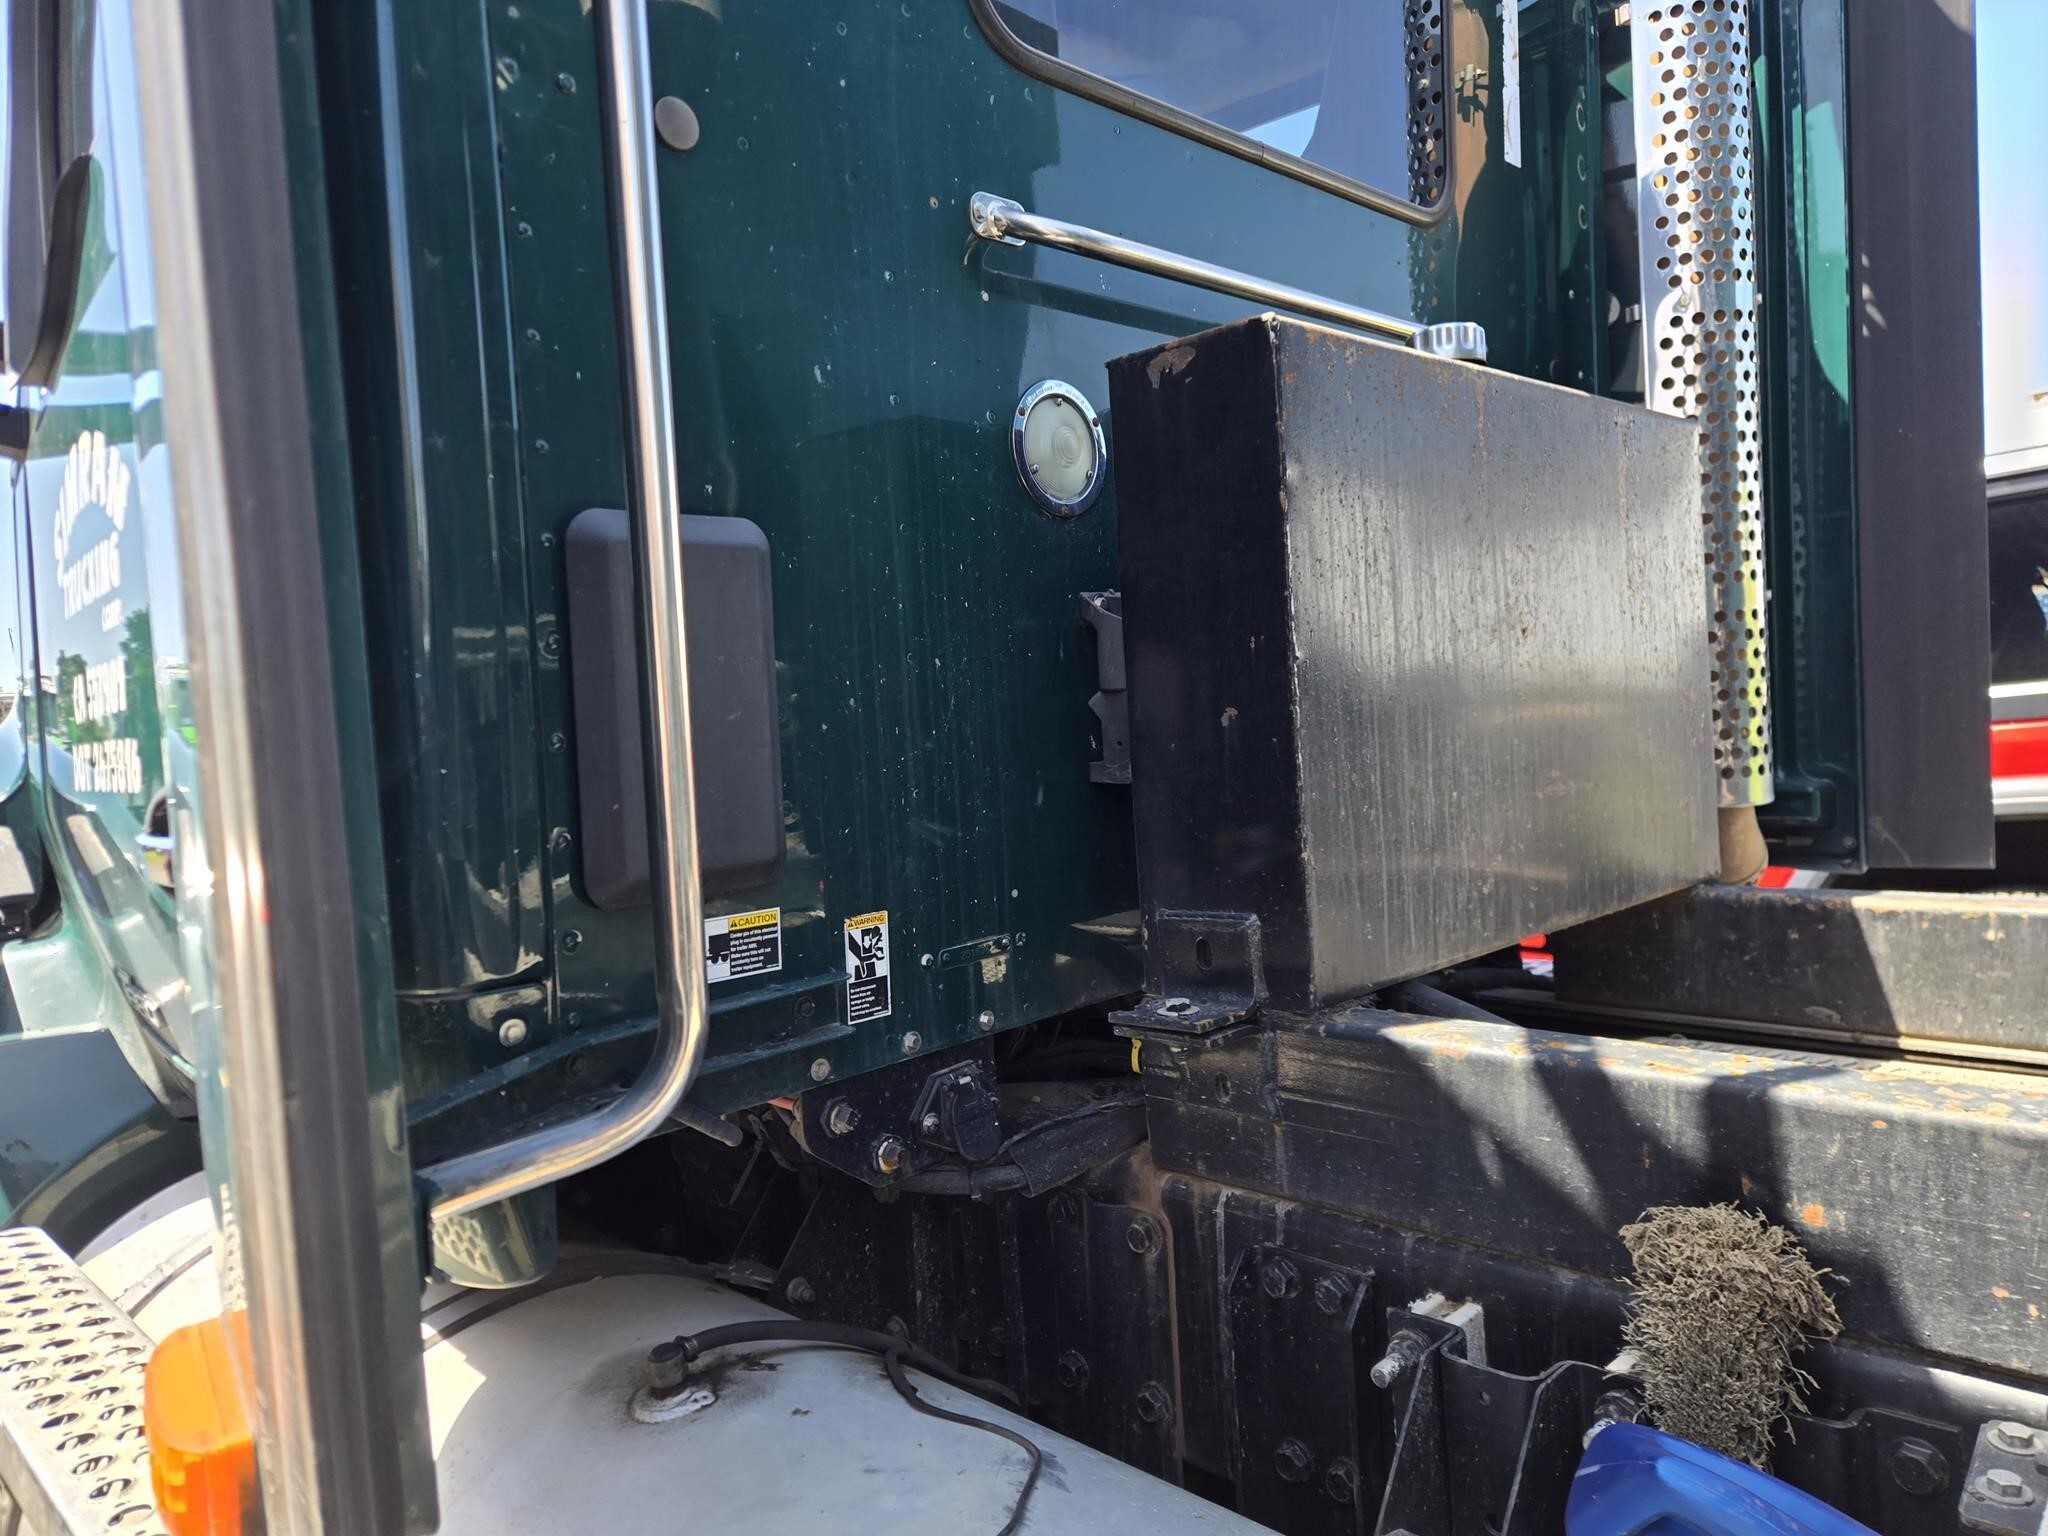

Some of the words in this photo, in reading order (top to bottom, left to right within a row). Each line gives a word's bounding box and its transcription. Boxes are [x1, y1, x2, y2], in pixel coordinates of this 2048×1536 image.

[63, 531, 120, 620] TRUCKING
[73, 743, 92, 792] DOT
[738, 912, 777, 927] CAUTION
[853, 914, 885, 927] WARNING
